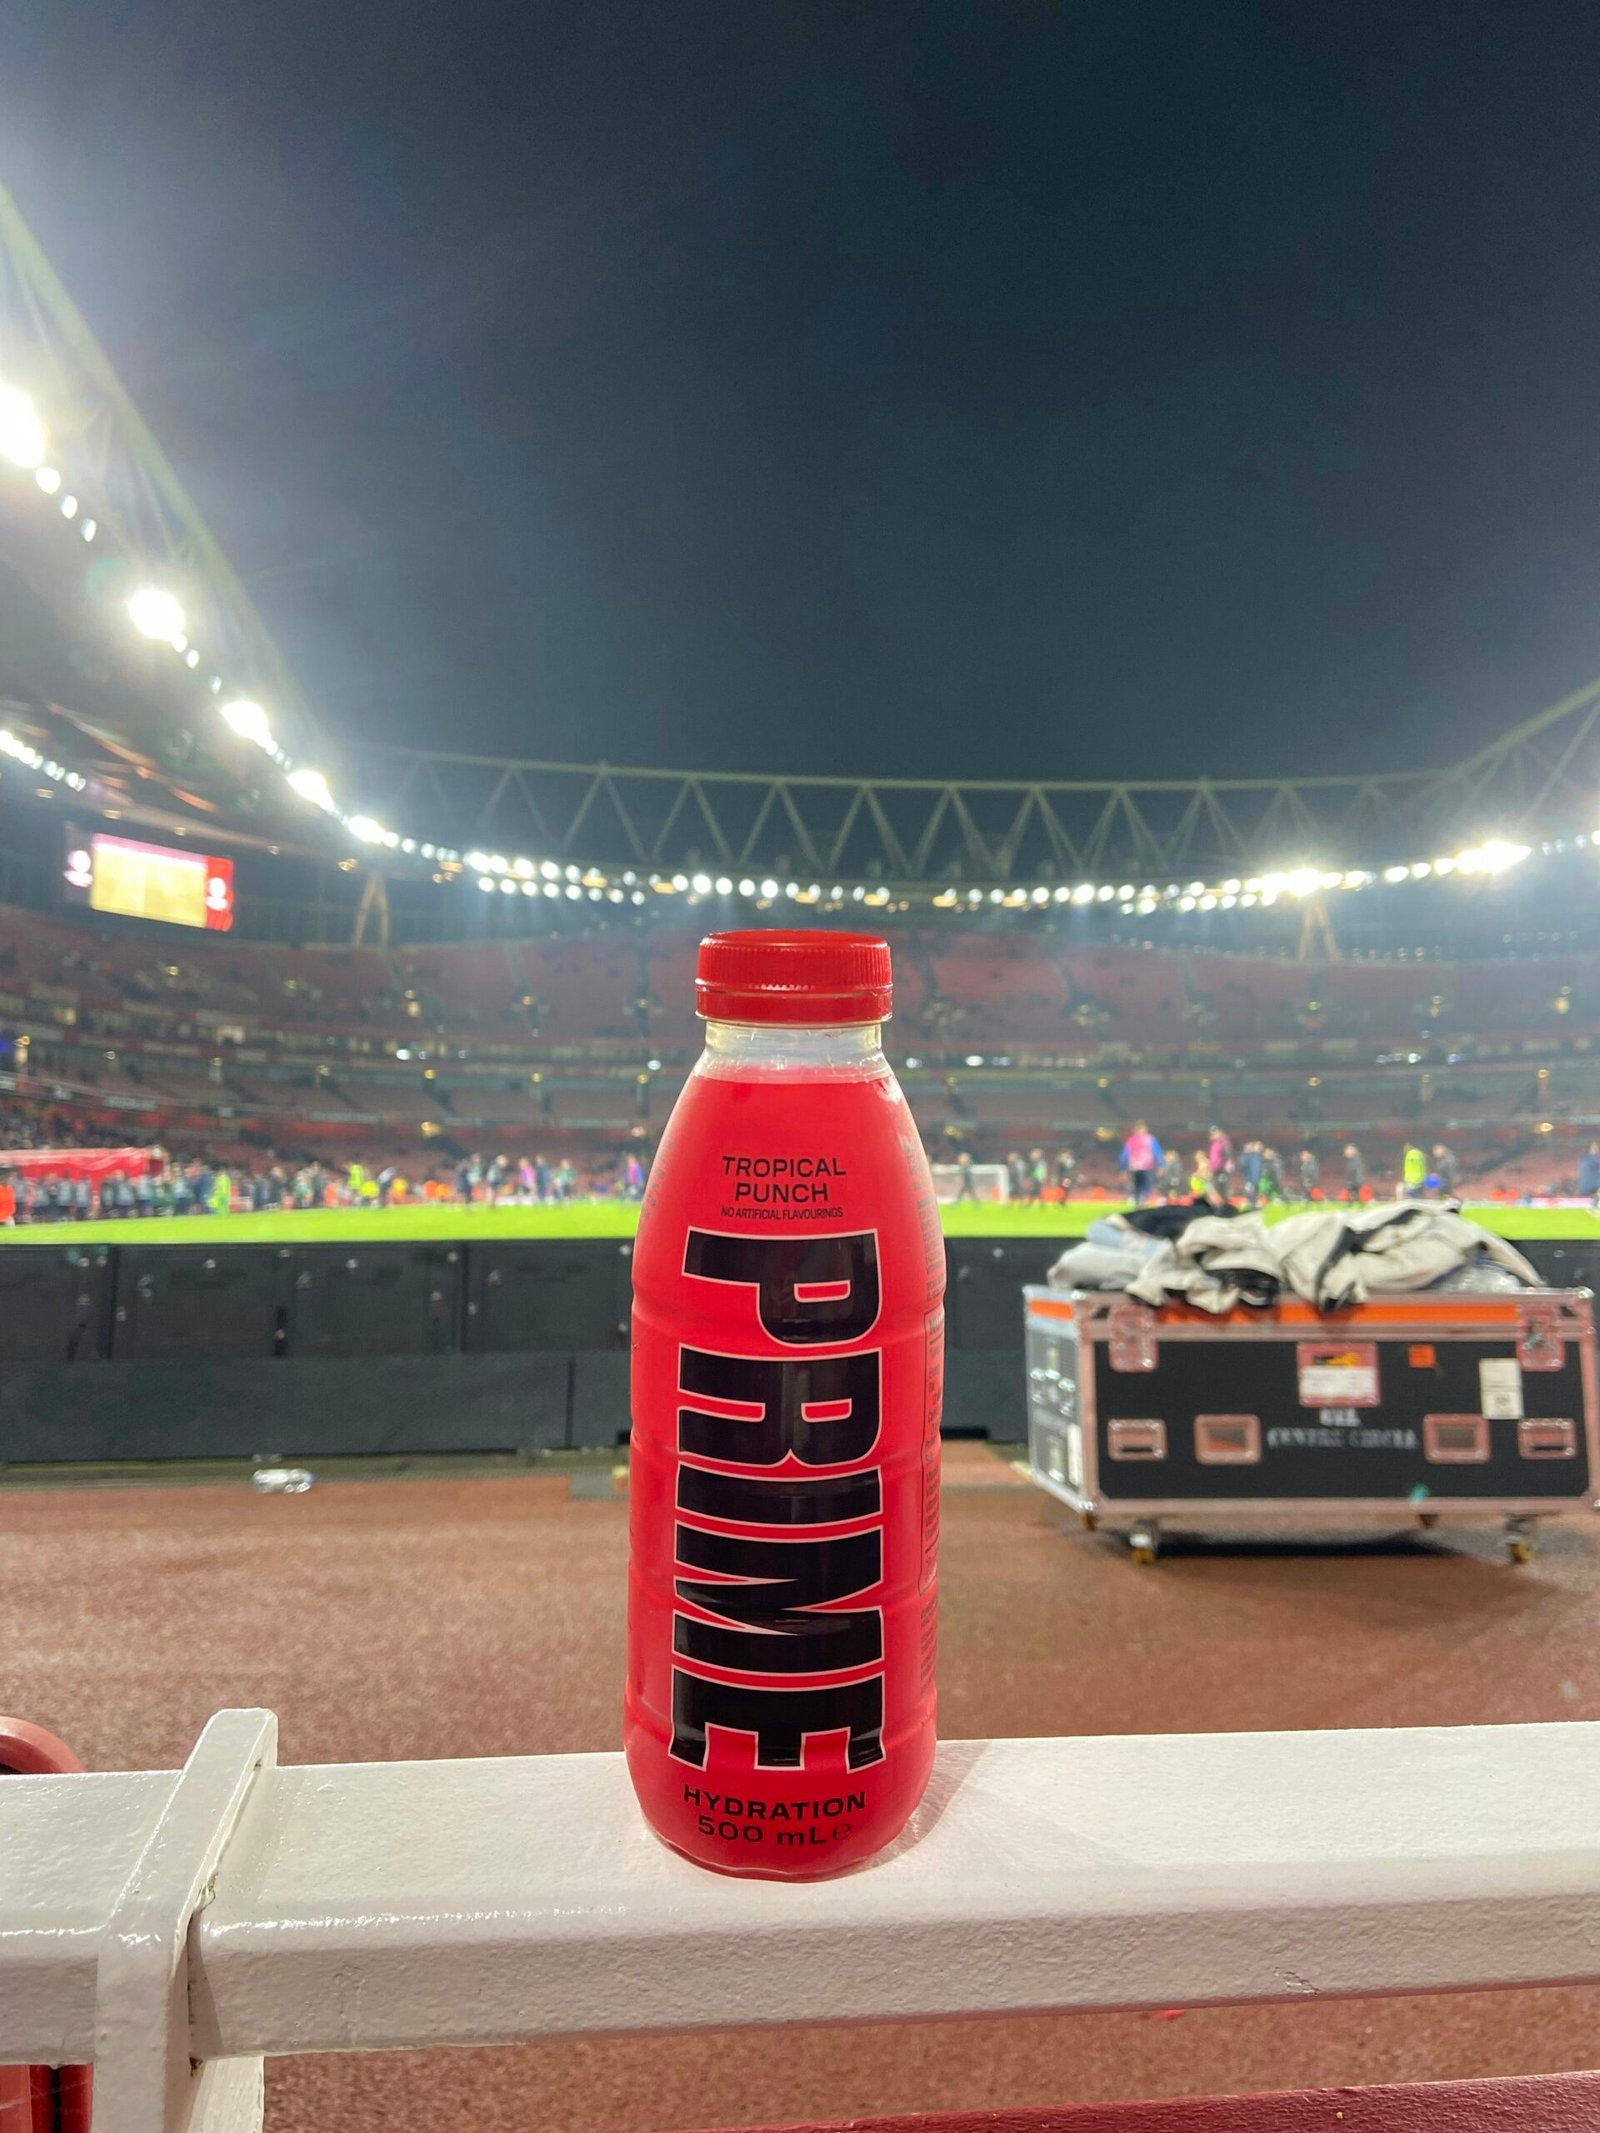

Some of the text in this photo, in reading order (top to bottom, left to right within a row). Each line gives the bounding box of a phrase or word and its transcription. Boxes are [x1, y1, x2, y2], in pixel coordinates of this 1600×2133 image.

[722, 1156, 847, 1178] TROPICAL
[735, 1182, 829, 1203] PUNCH
[721, 1206, 844, 1220] NO ARTIFICIAL FLAVOURINGS
[668, 1225, 887, 1774] PRIME
[683, 1783, 867, 1821] HYDRATION
[698, 1814, 764, 1843] 500
